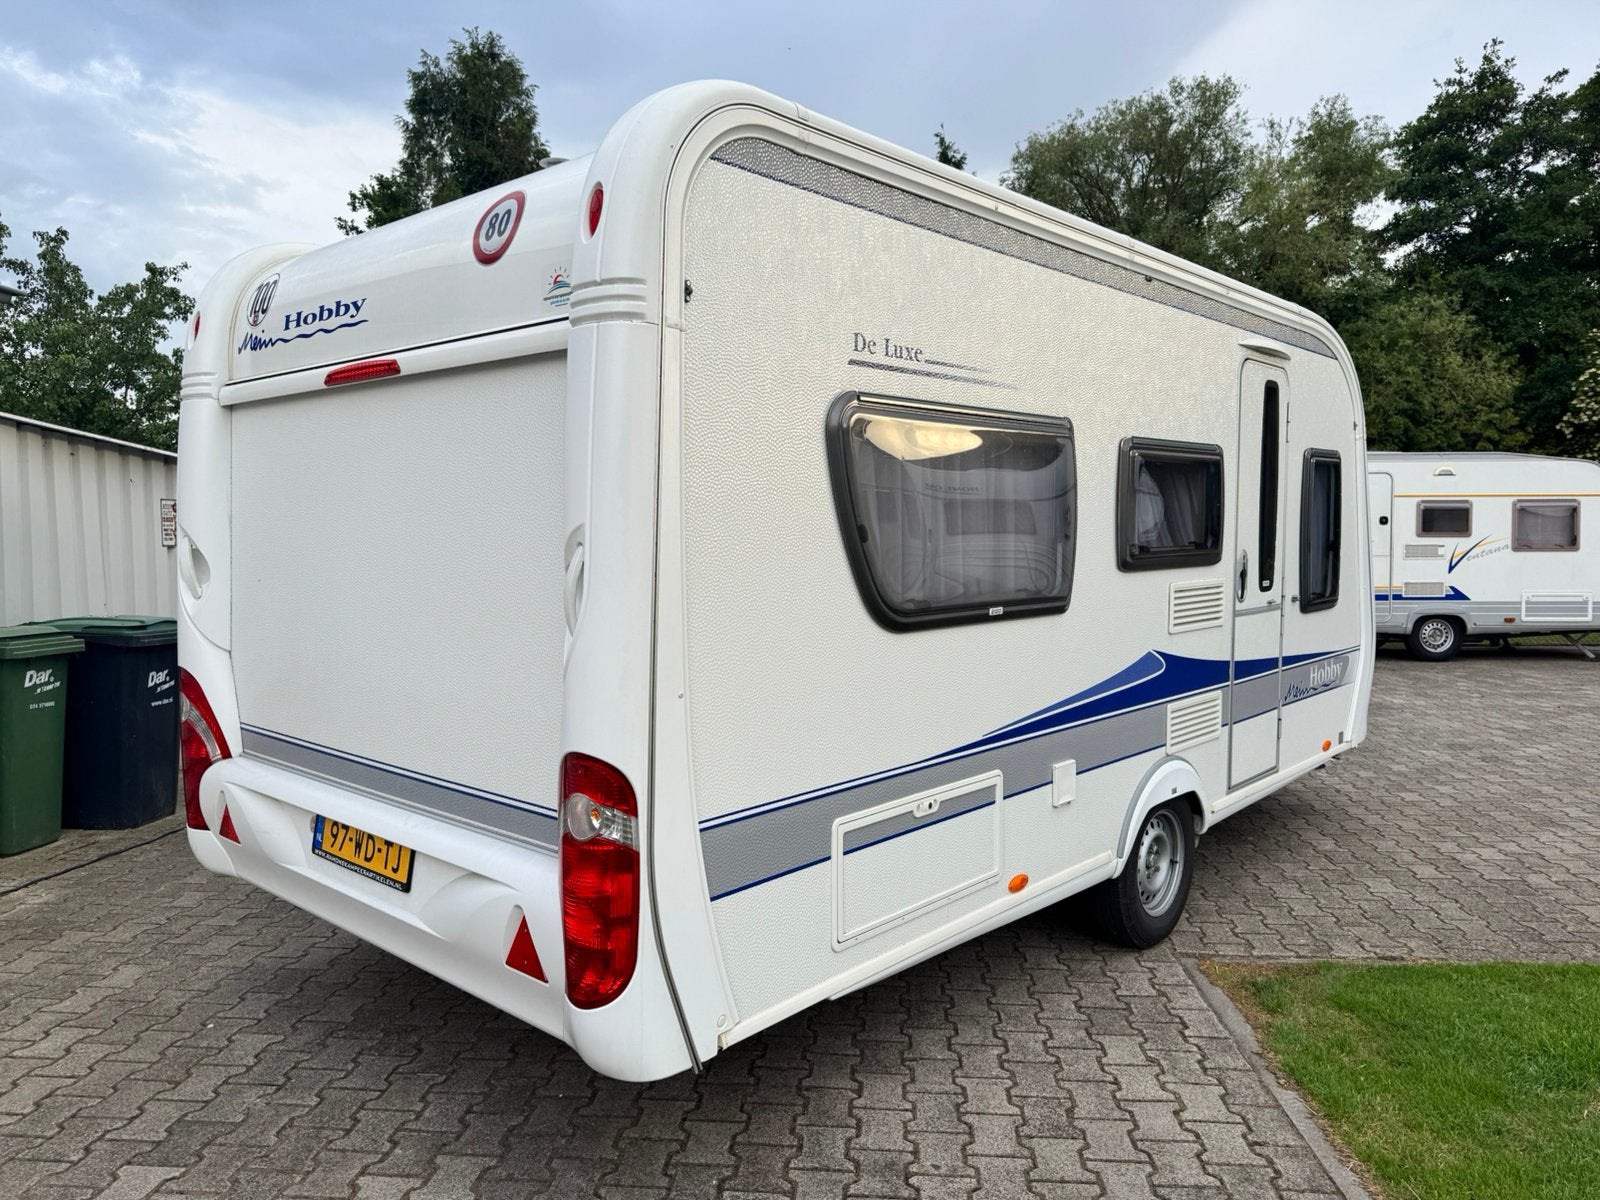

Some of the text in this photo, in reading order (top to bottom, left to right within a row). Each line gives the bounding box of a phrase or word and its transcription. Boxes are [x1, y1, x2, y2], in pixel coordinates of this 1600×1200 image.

[485, 208, 512, 242] 80
[249, 279, 278, 318] 100
[283, 297, 367, 331] Hobby
[238, 329, 280, 355] Mein
[853, 331, 923, 362] De Luxe
[1448, 533, 1511, 574] Ventana
[1310, 659, 1344, 687] Hobby
[1284, 680, 1311, 702] Mein
[330, 820, 403, 875] 97-WD-TJ
